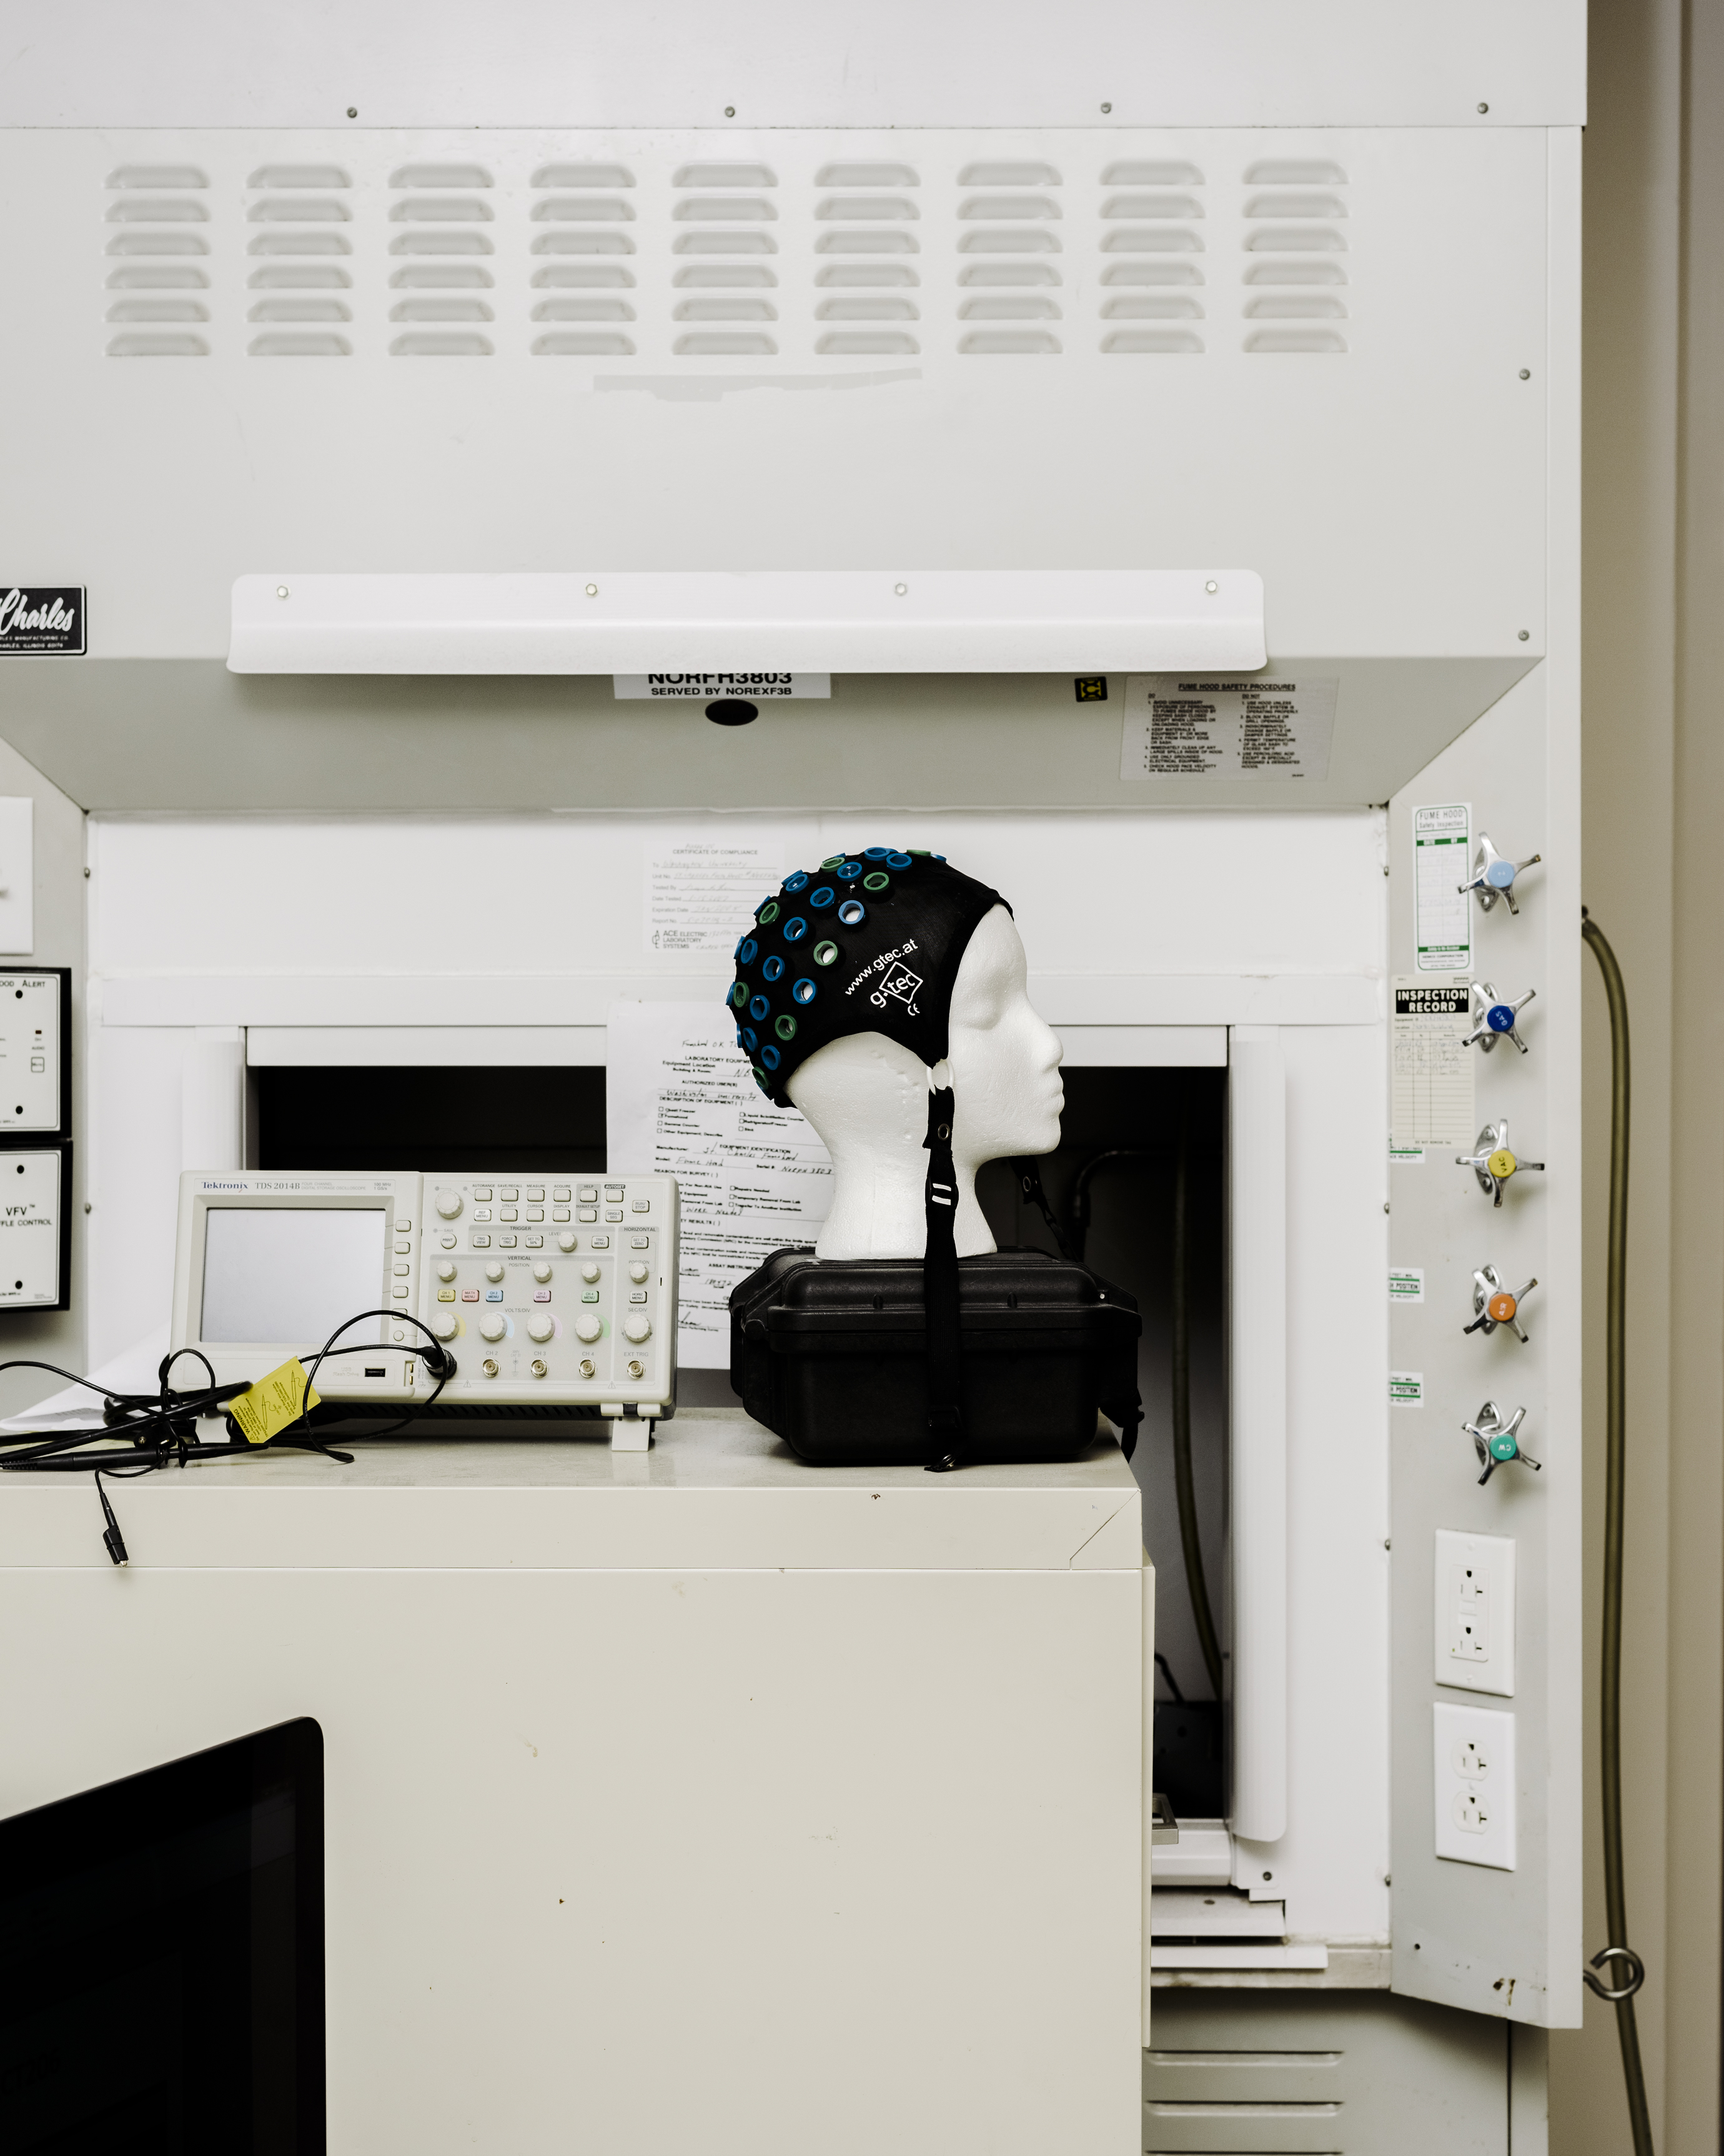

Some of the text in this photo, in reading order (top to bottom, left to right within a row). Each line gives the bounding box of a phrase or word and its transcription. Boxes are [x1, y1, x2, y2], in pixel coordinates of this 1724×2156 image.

[705, 687, 721, 695] BY
[726, 687, 792, 695] NOREXF3B
[1420, 809, 1462, 819] FUME HOOD
[1437, 821, 1464, 829] Inspection
[845, 939, 918, 996] www.gtec.at
[1397, 989, 1467, 1001] INSPECTION
[1409, 1001, 1456, 1012] RECORD
[1495, 1011, 1508, 1026] GAS
[1499, 1157, 1507, 1173] VAC
[201, 1181, 249, 1190] Tektronix
[6, 1207, 27, 1216] VFV
[1499, 1302, 1508, 1316] AIR
[234, 1408, 250, 1435] WARNING
